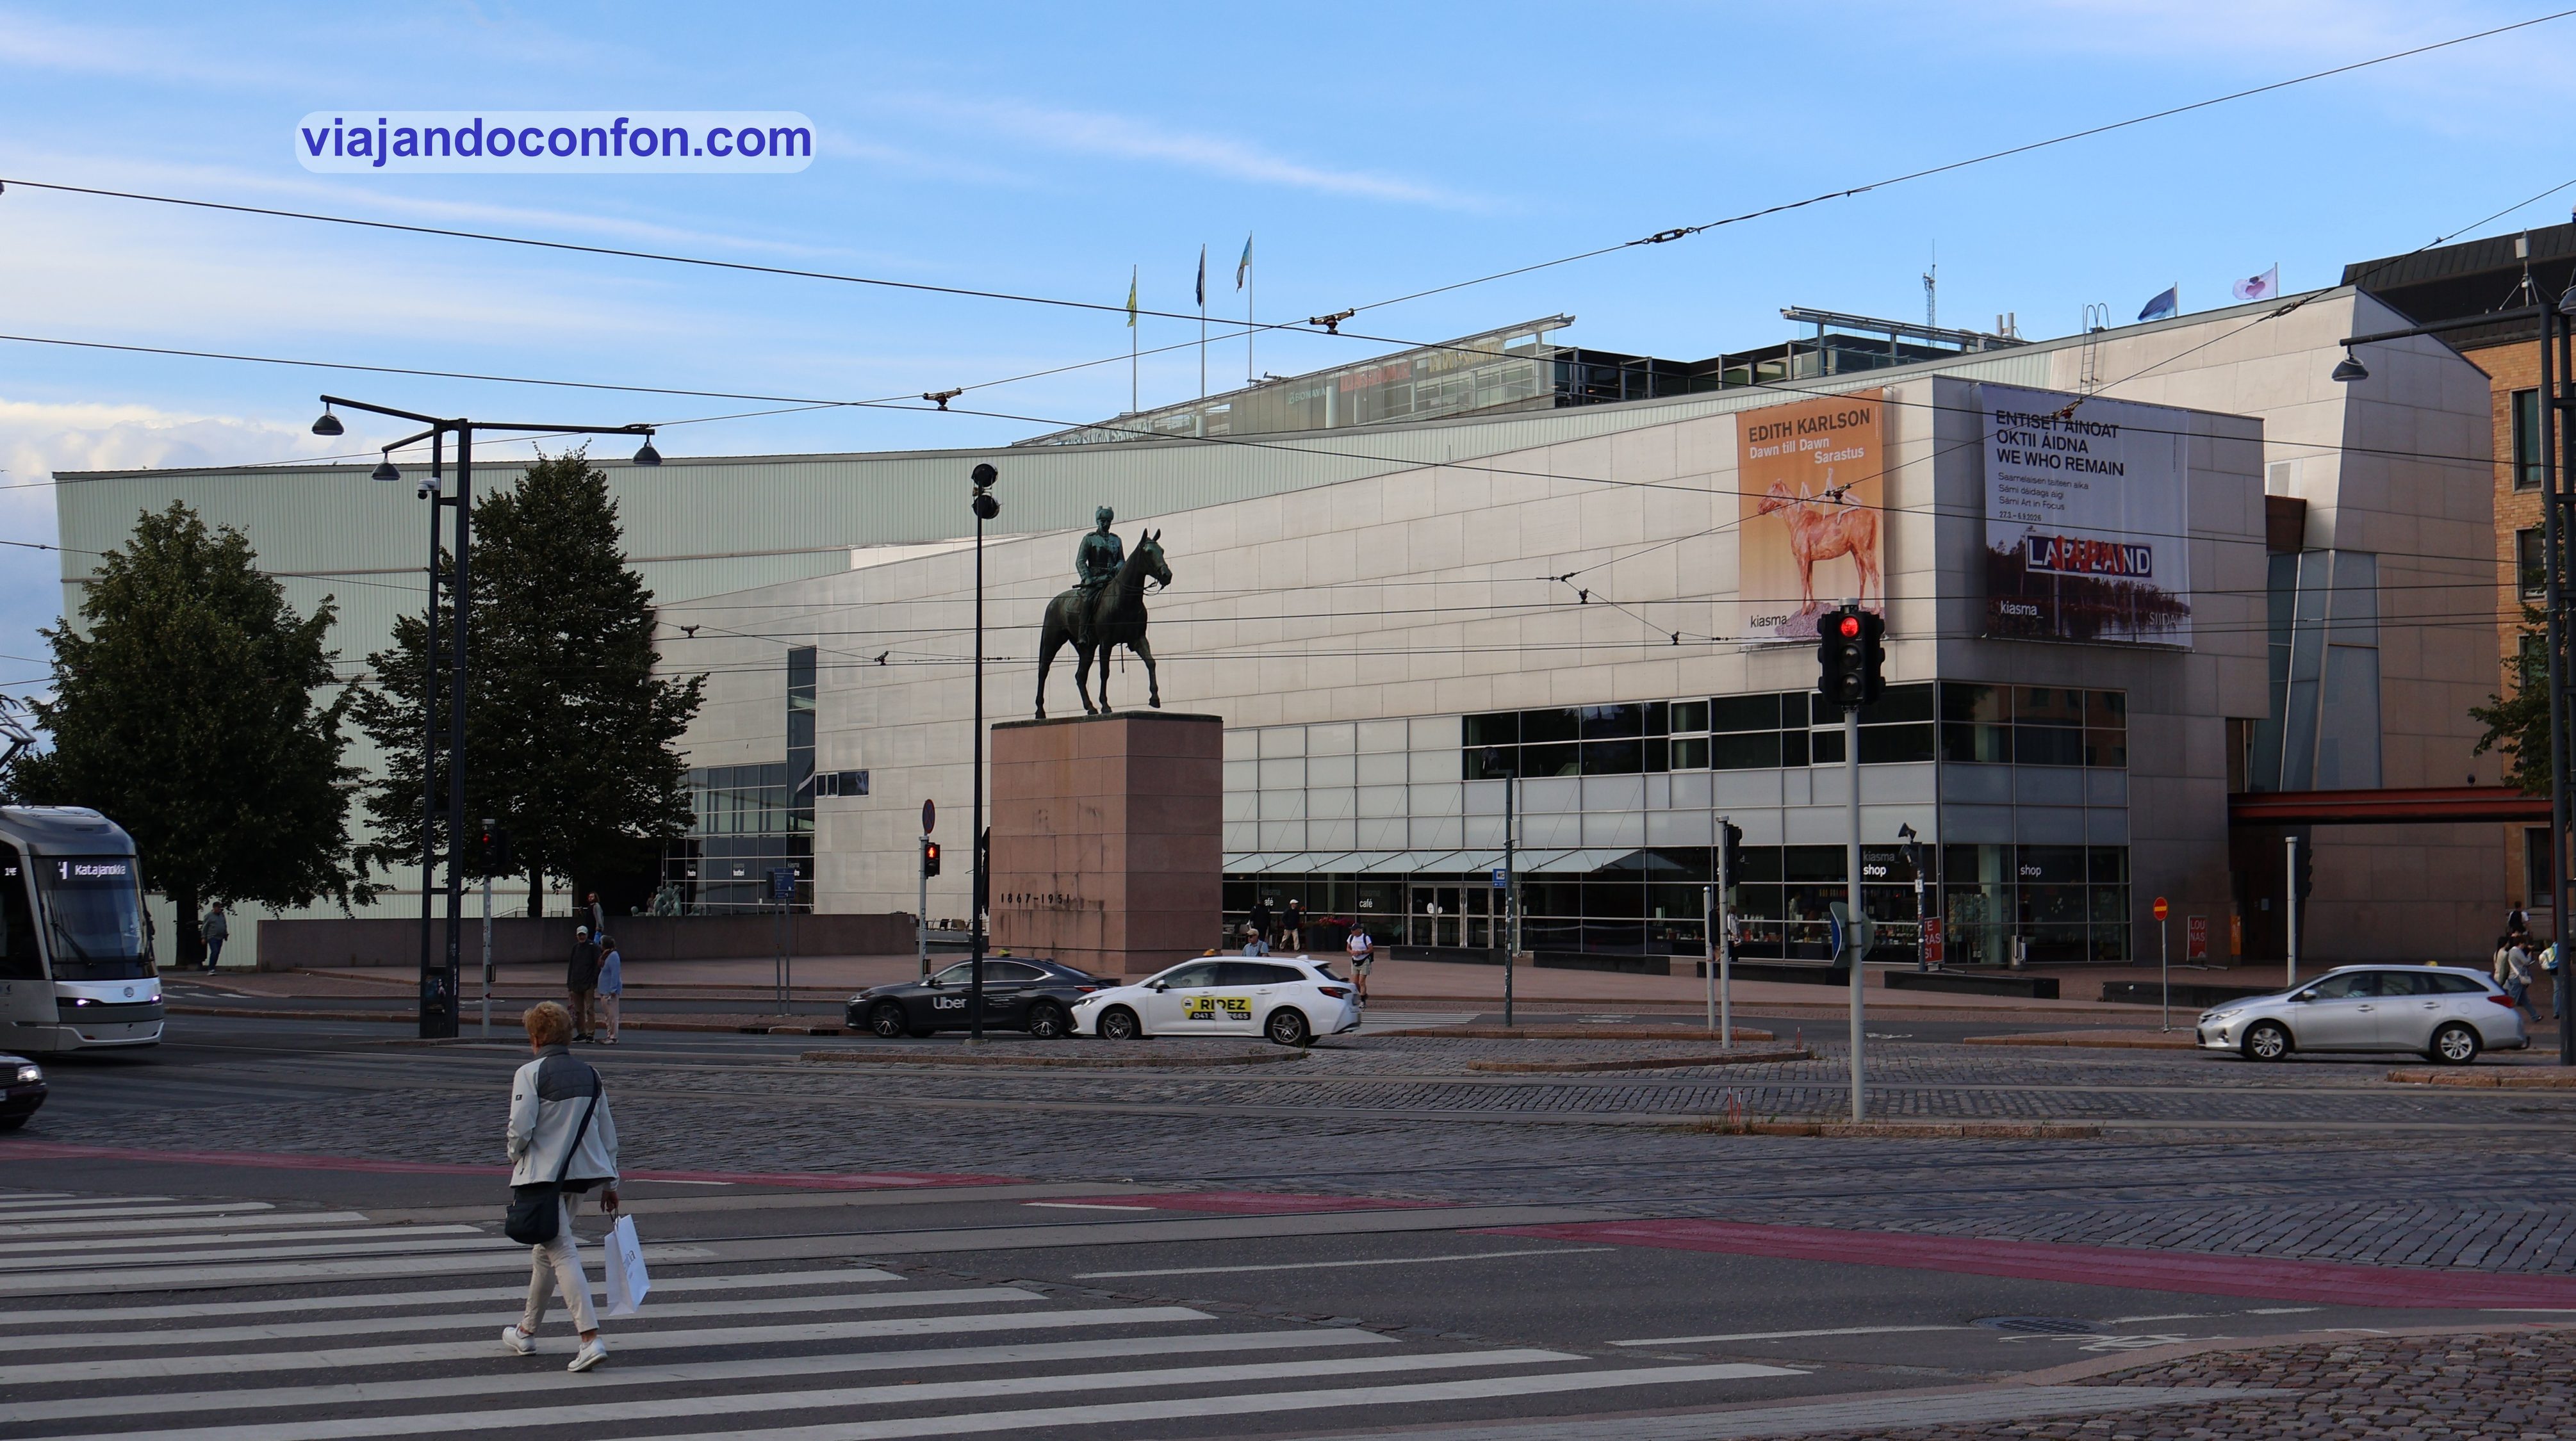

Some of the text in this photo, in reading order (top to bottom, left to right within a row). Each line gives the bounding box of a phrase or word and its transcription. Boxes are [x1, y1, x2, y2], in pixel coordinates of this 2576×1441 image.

[1749, 421, 1793, 443] EDITH
[1798, 408, 1870, 435] KARLSON
[1996, 410, 2119, 438] ENTISET AINOAT
[1750, 437, 1830, 459] Dawn till Dawn
[1997, 429, 2088, 453] OKTII ÁIDNA
[1814, 448, 1864, 464] Sarastus
[1997, 448, 2124, 476] WE WHO REMAIN
[2042, 501, 2065, 510] Focus
[1863, 863, 1887, 877] shop
[2020, 863, 2042, 878] shop
[1264, 897, 1274, 906] afé
[1359, 898, 1373, 908] café
[2191, 920, 2205, 929] LOU
[2190, 932, 2205, 941] NAS
[933, 997, 967, 1009] Uber
[1201, 999, 1245, 1010] RIDEZ
